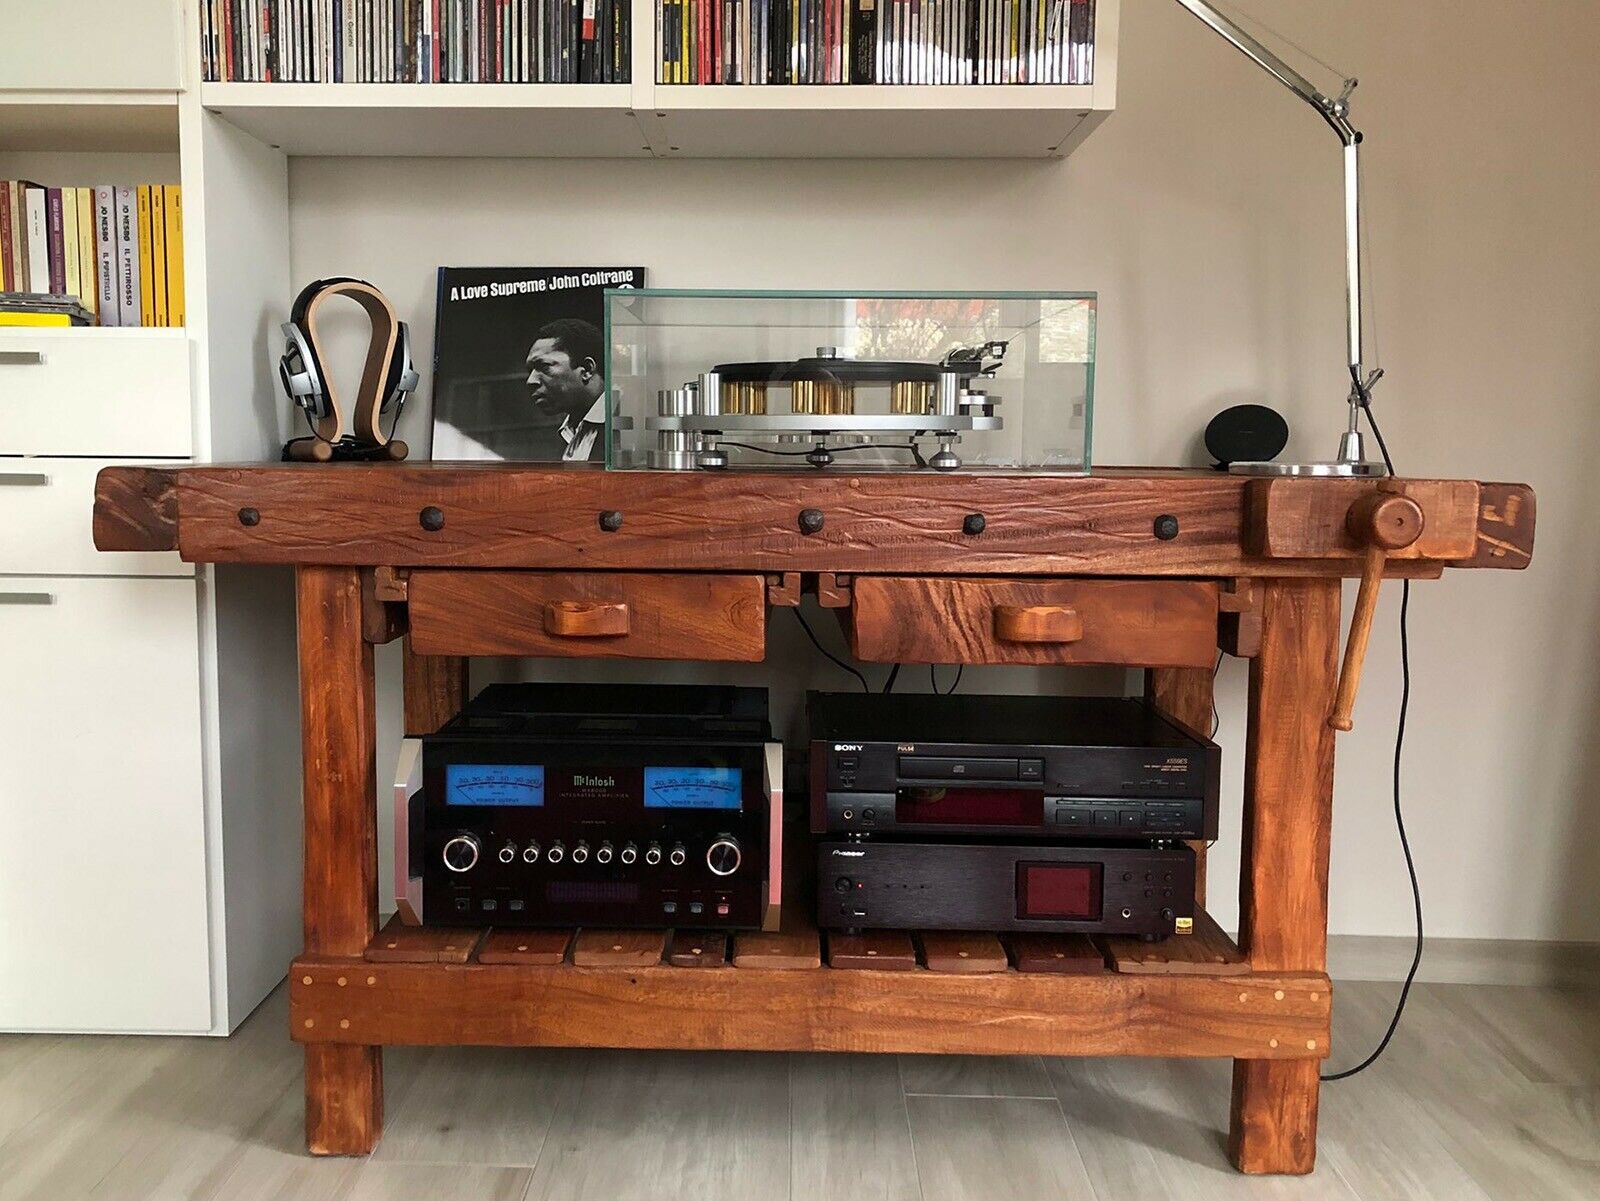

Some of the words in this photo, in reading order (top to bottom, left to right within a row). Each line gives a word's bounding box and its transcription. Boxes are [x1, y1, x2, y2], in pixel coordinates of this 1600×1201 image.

[100, 206, 108, 215] JO
[122, 205, 129, 214] JO
[124, 248, 131, 256] IL
[103, 261, 111, 301] PIPISTRELLO
[125, 258, 133, 306] PETTIROSSO
[450, 287, 460, 302] A
[460, 284, 489, 300] Love
[490, 279, 546, 298] Supreme
[549, 275, 581, 291] John
[581, 269, 634, 288] Coltrane
[834, 744, 863, 752] SONY
[573, 775, 615, 787] McIntosh
